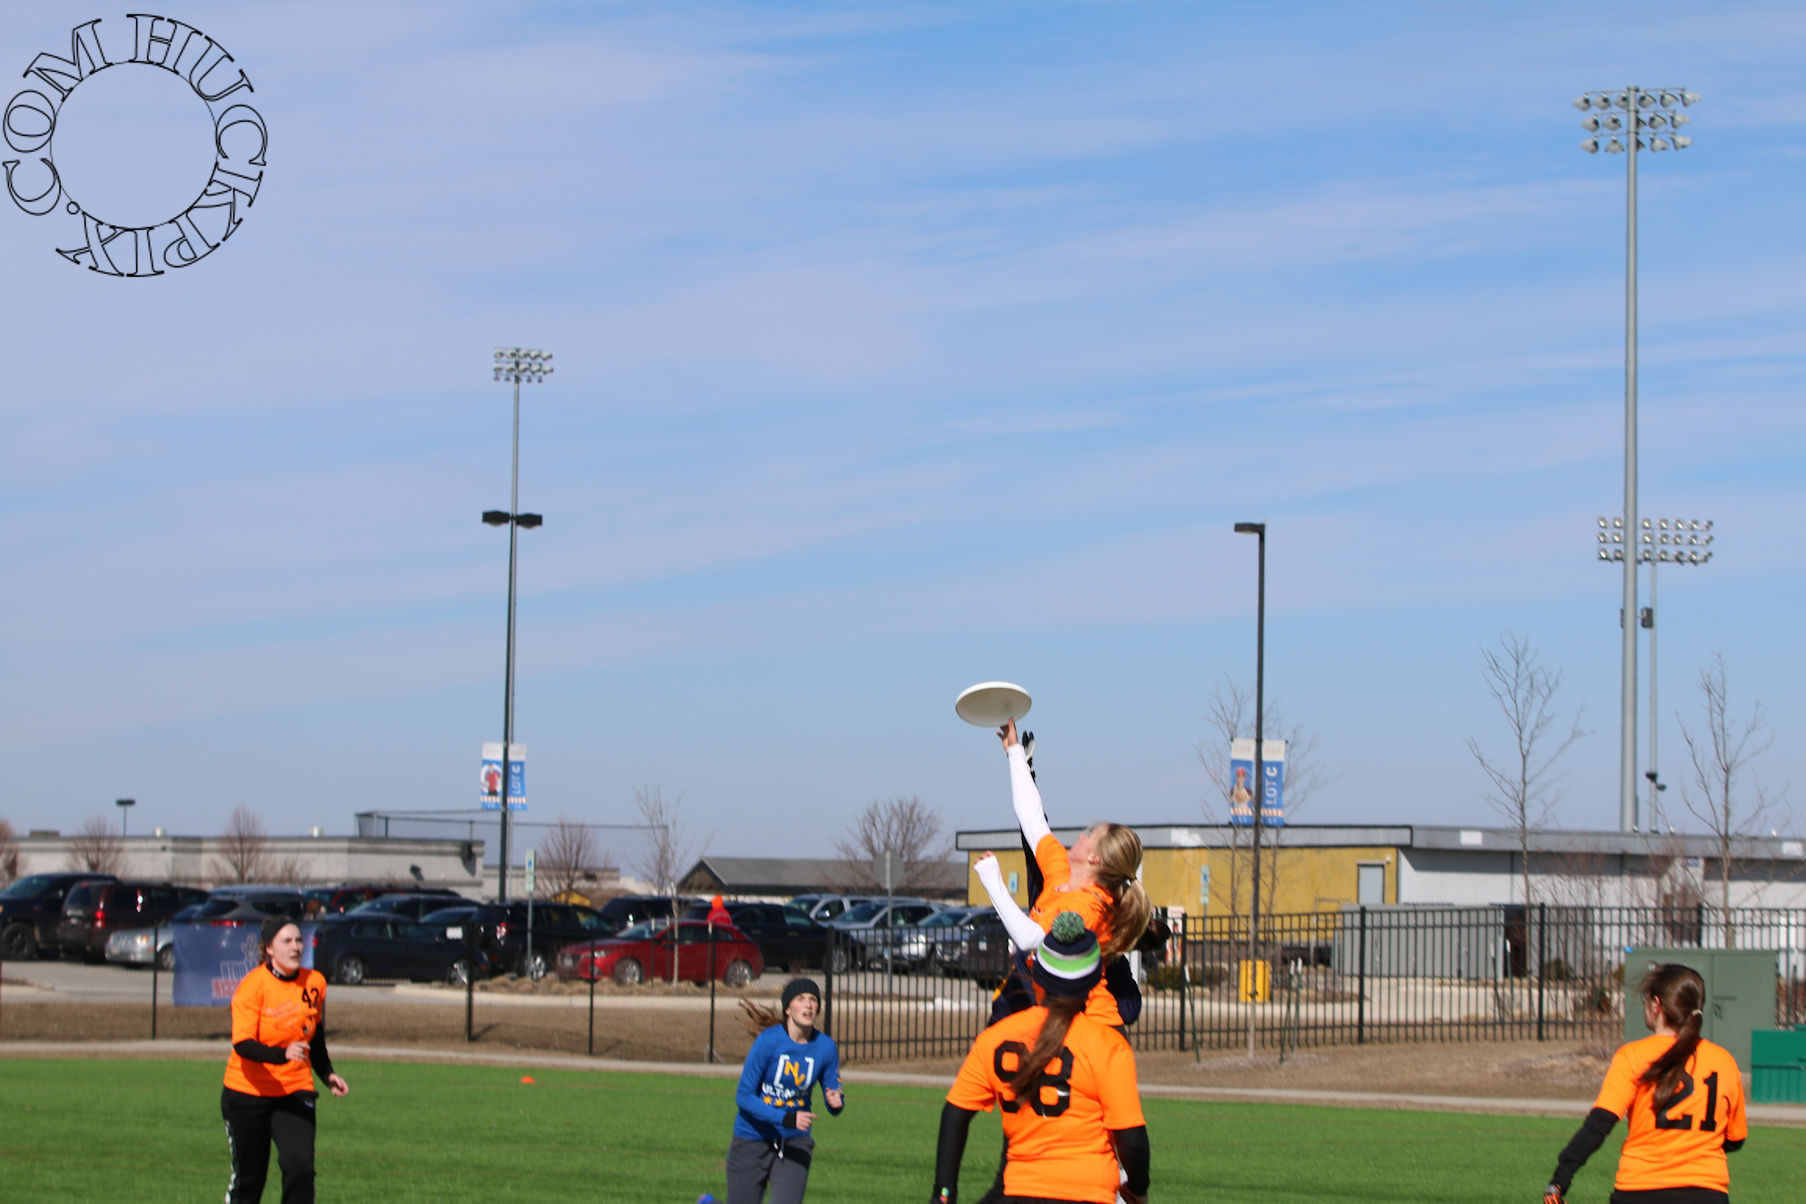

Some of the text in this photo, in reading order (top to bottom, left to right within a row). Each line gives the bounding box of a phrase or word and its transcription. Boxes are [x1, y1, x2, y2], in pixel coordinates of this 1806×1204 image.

[1265, 765, 1278, 777] C
[1265, 779, 1278, 805] LOT
[993, 1040, 1075, 1117] 98
[1654, 1070, 1718, 1132] 21
